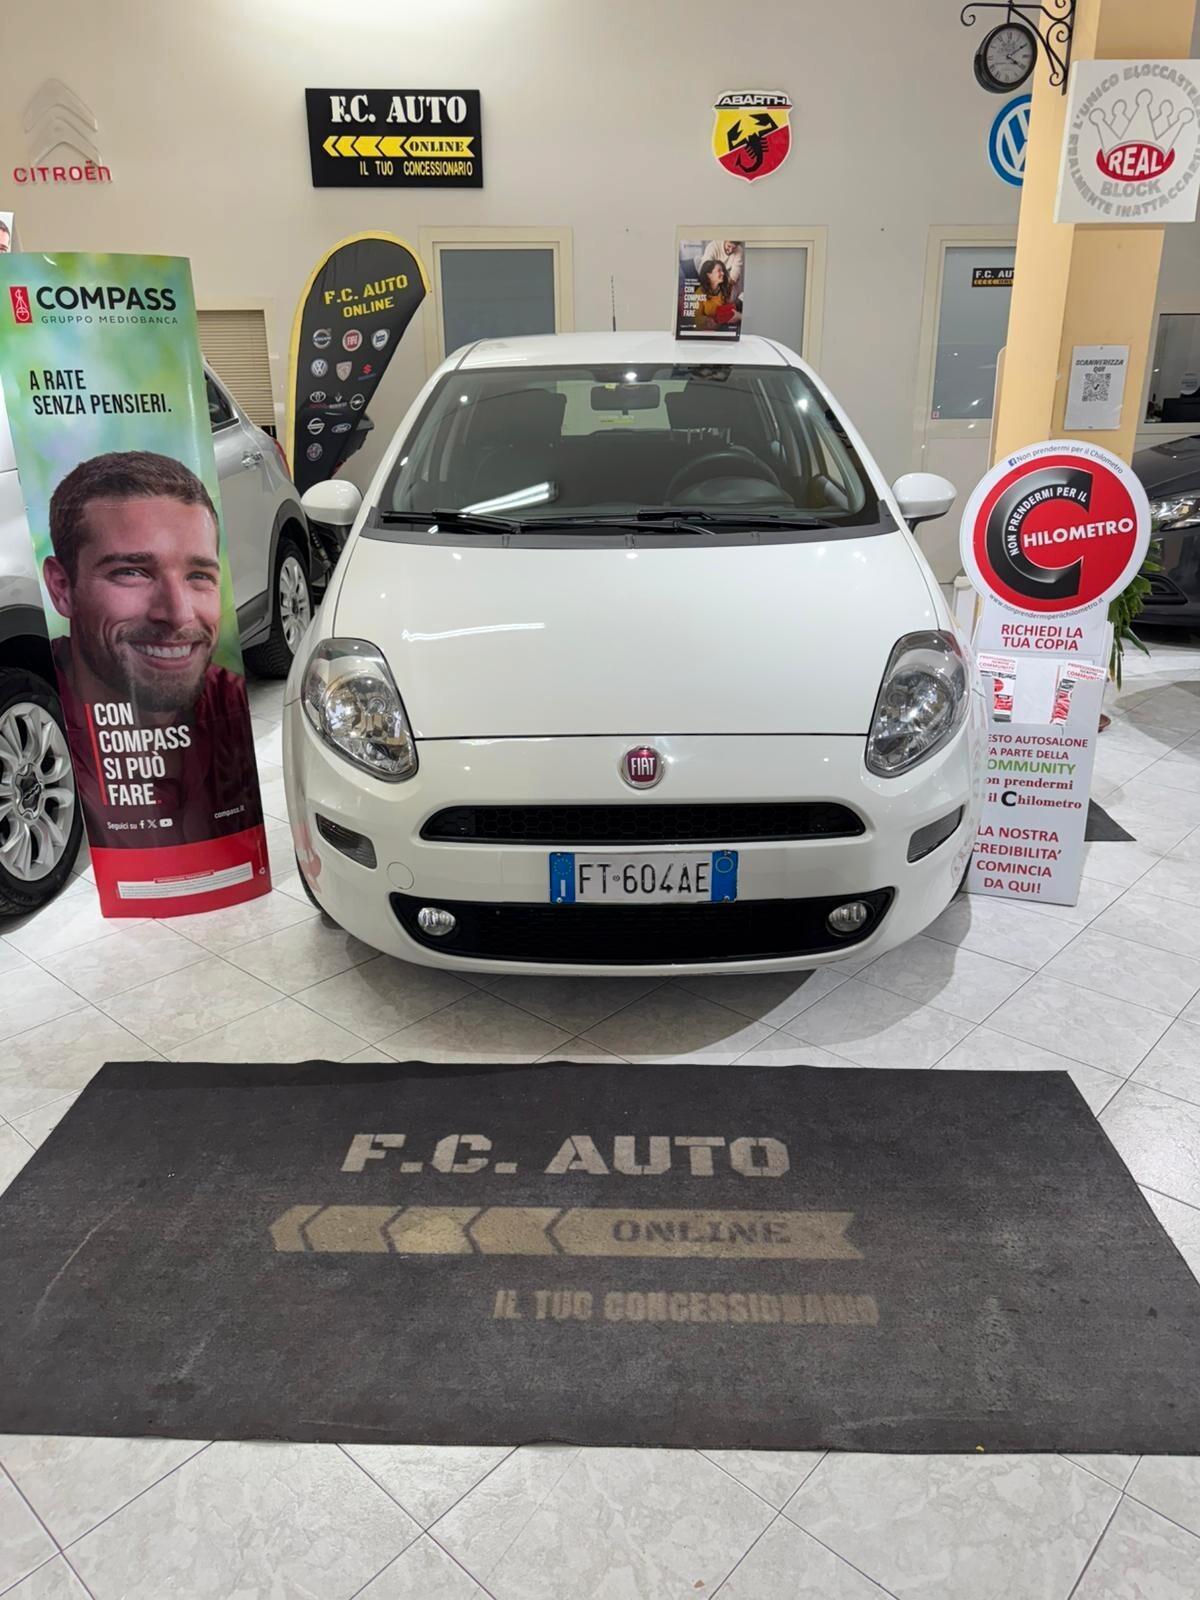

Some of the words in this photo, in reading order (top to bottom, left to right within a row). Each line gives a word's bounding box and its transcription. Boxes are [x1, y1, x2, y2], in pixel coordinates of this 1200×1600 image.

[329, 94, 376, 123] F.C.
[386, 96, 467, 123] AUTO
[720, 94, 786, 106] ABARTH
[409, 141, 464, 152] ONLINE
[359, 161, 369, 175] IL
[375, 160, 393, 175] TUO
[403, 161, 473, 176] CONCESSIONARIO
[1108, 146, 1162, 177] REAL
[1100, 179, 1161, 198] BLOCK
[998, 270, 1014, 278] AU
[36, 286, 177, 311] COMPASS
[323, 287, 359, 305] F.C.
[363, 274, 408, 297] AUTO
[343, 297, 394, 318] ONLINE
[42, 315, 93, 324] GRUPPO
[99, 315, 178, 324] MEDIOBANCA
[29, 370, 40, 391] A
[43, 369, 86, 390] RATE
[33, 395, 86, 415] SENZA
[90, 393, 172, 414] PENSIERI.
[1016, 452, 1031, 463] Non
[1032, 445, 1070, 457] prendermi
[1090, 449, 1123, 475] Chilometro
[1056, 486, 1076, 498] PER
[1077, 490, 1088, 503] IL
[1008, 487, 1054, 531] PRENDERMI
[1007, 533, 1020, 557] NON
[1001, 624, 1062, 638] RICHIEDI
[1066, 626, 1083, 639] LA
[1002, 636, 1031, 648] TUA
[1035, 638, 1079, 651] COPIA
[94, 703, 134, 726] CON
[98, 724, 191, 753] COMPASS
[1015, 735, 1088, 748] AUTOSALONE
[1001, 748, 1033, 758] PARTE
[1036, 750, 1069, 760] DELLA
[103, 758, 122, 780] SI
[126, 751, 166, 778] PUÒ
[631, 757, 655, 776] FIAT
[987, 759, 1076, 775] OMMUNITY
[986, 776, 1000, 785] on
[1004, 777, 1073, 790] prendermi
[988, 792, 997, 802] il
[1001, 791, 1082, 809] Chilometro
[214, 805, 245, 819] compass.it
[107, 821, 129, 831] Seguici
[977, 825, 994, 837] LA
[999, 827, 1059, 842] NOSTRA
[976, 860, 1052, 877] COMINCIA
[984, 878, 1003, 889] DA
[1008, 880, 1041, 893] QUI!
[340, 1133, 517, 1174] F.C.
[544, 1134, 791, 1178] AUTO
[612, 1218, 792, 1245] ONLINE
[493, 1290, 522, 1319] IL
[533, 1290, 593, 1320] TUO
